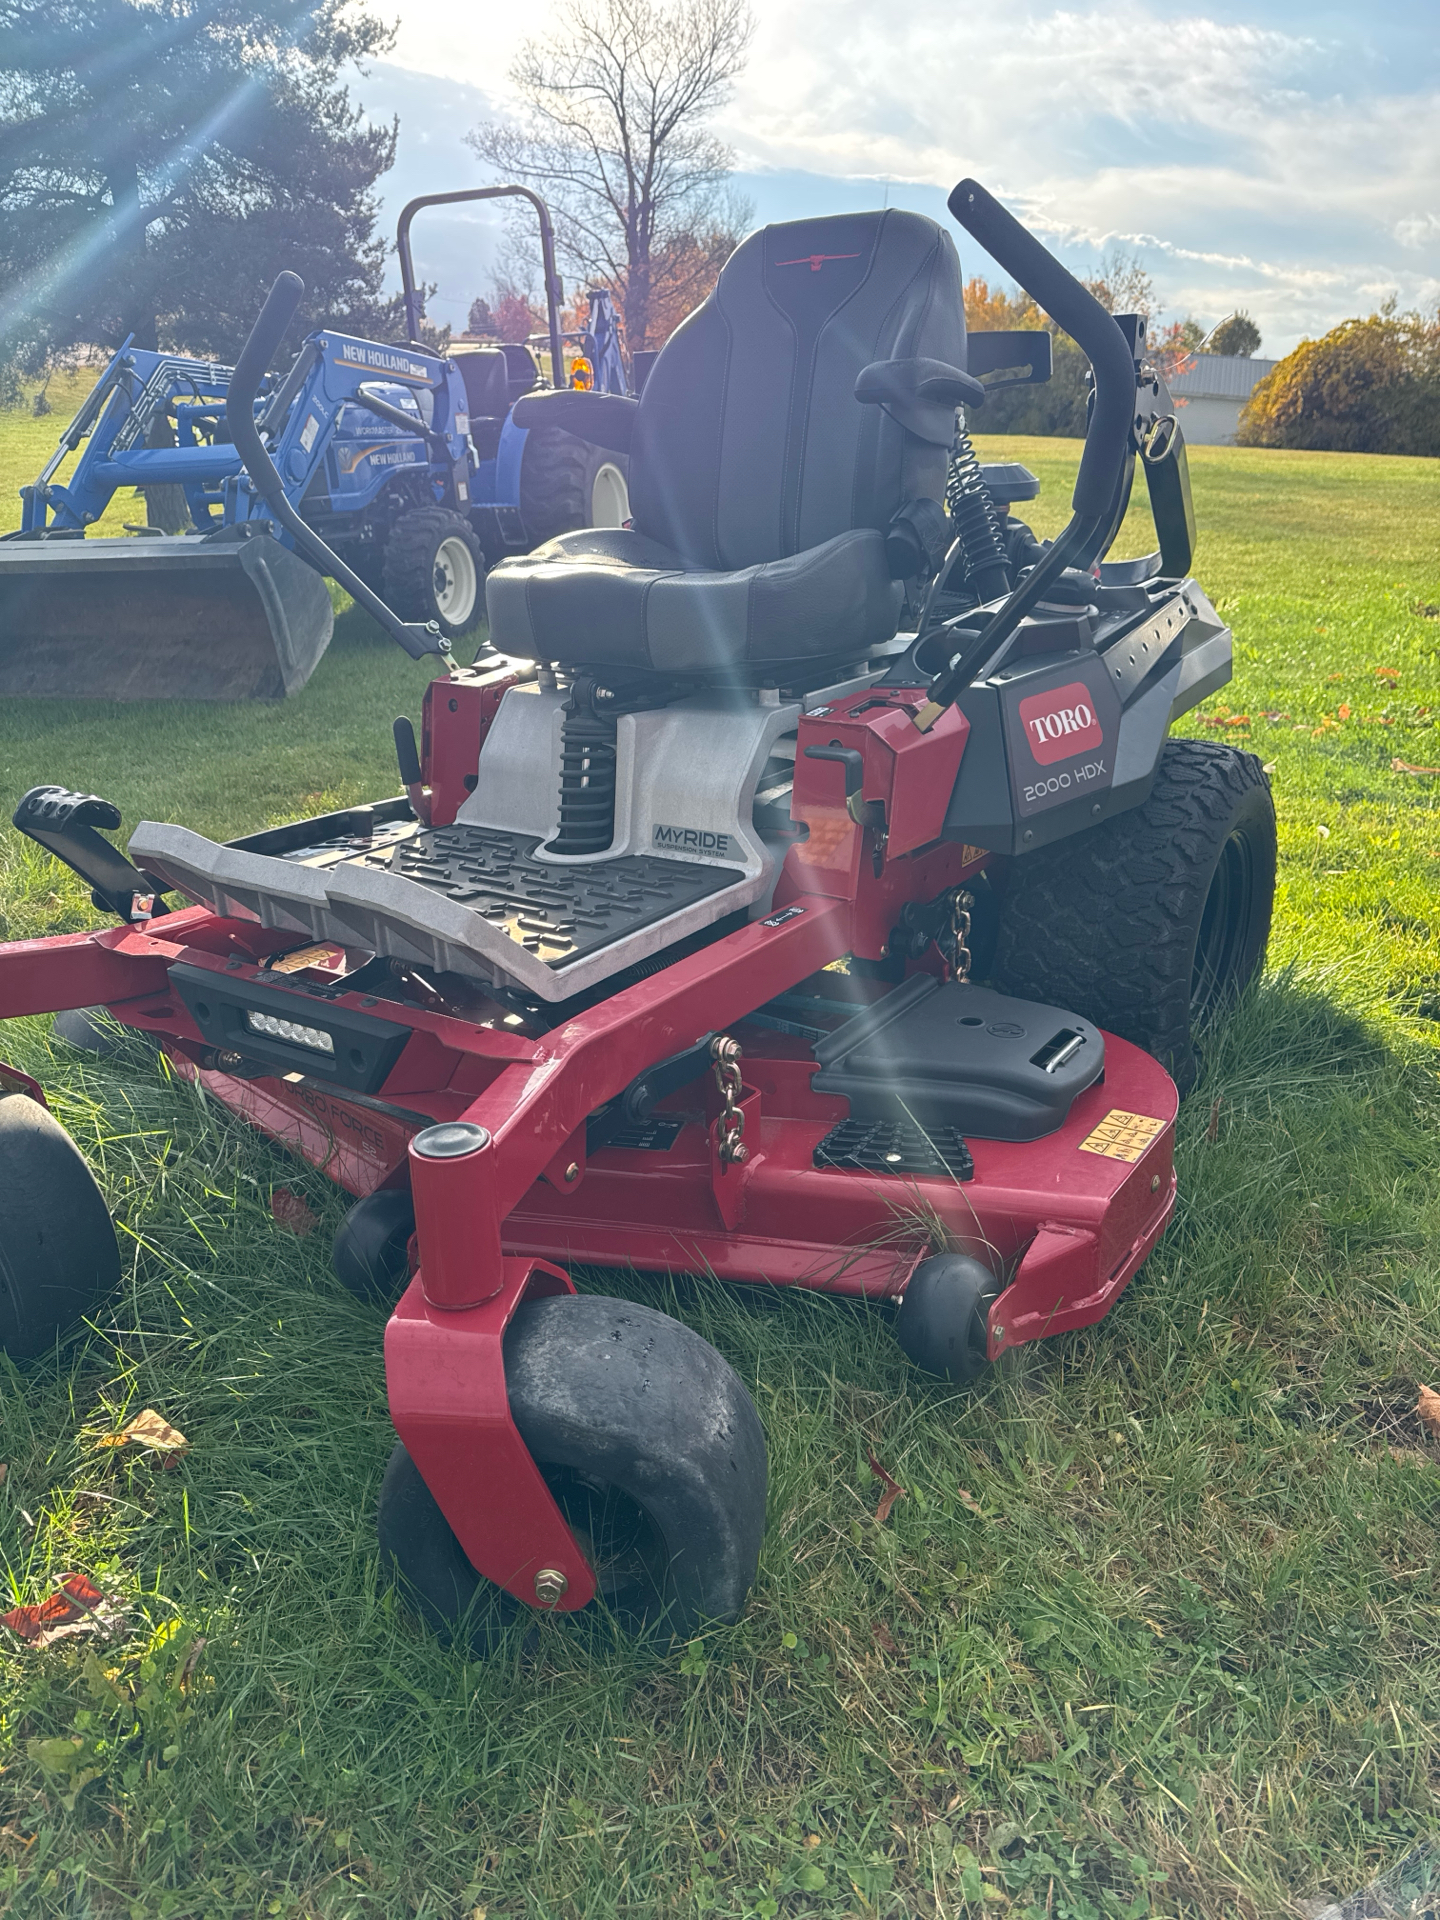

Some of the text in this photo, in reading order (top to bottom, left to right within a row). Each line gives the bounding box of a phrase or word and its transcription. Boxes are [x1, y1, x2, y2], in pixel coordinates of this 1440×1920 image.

[343, 344, 366, 363] NEW
[367, 349, 409, 373] HOLLAND
[370, 451, 416, 466] NEW HOLLAND
[1029, 703, 1092, 744] TORO
[1023, 759, 1107, 802] 2000 HDX
[657, 842, 726, 858] SUSPENSION SYSTEM
[330, 1104, 385, 1151] FORCE
[361, 1140, 378, 1159] 52
